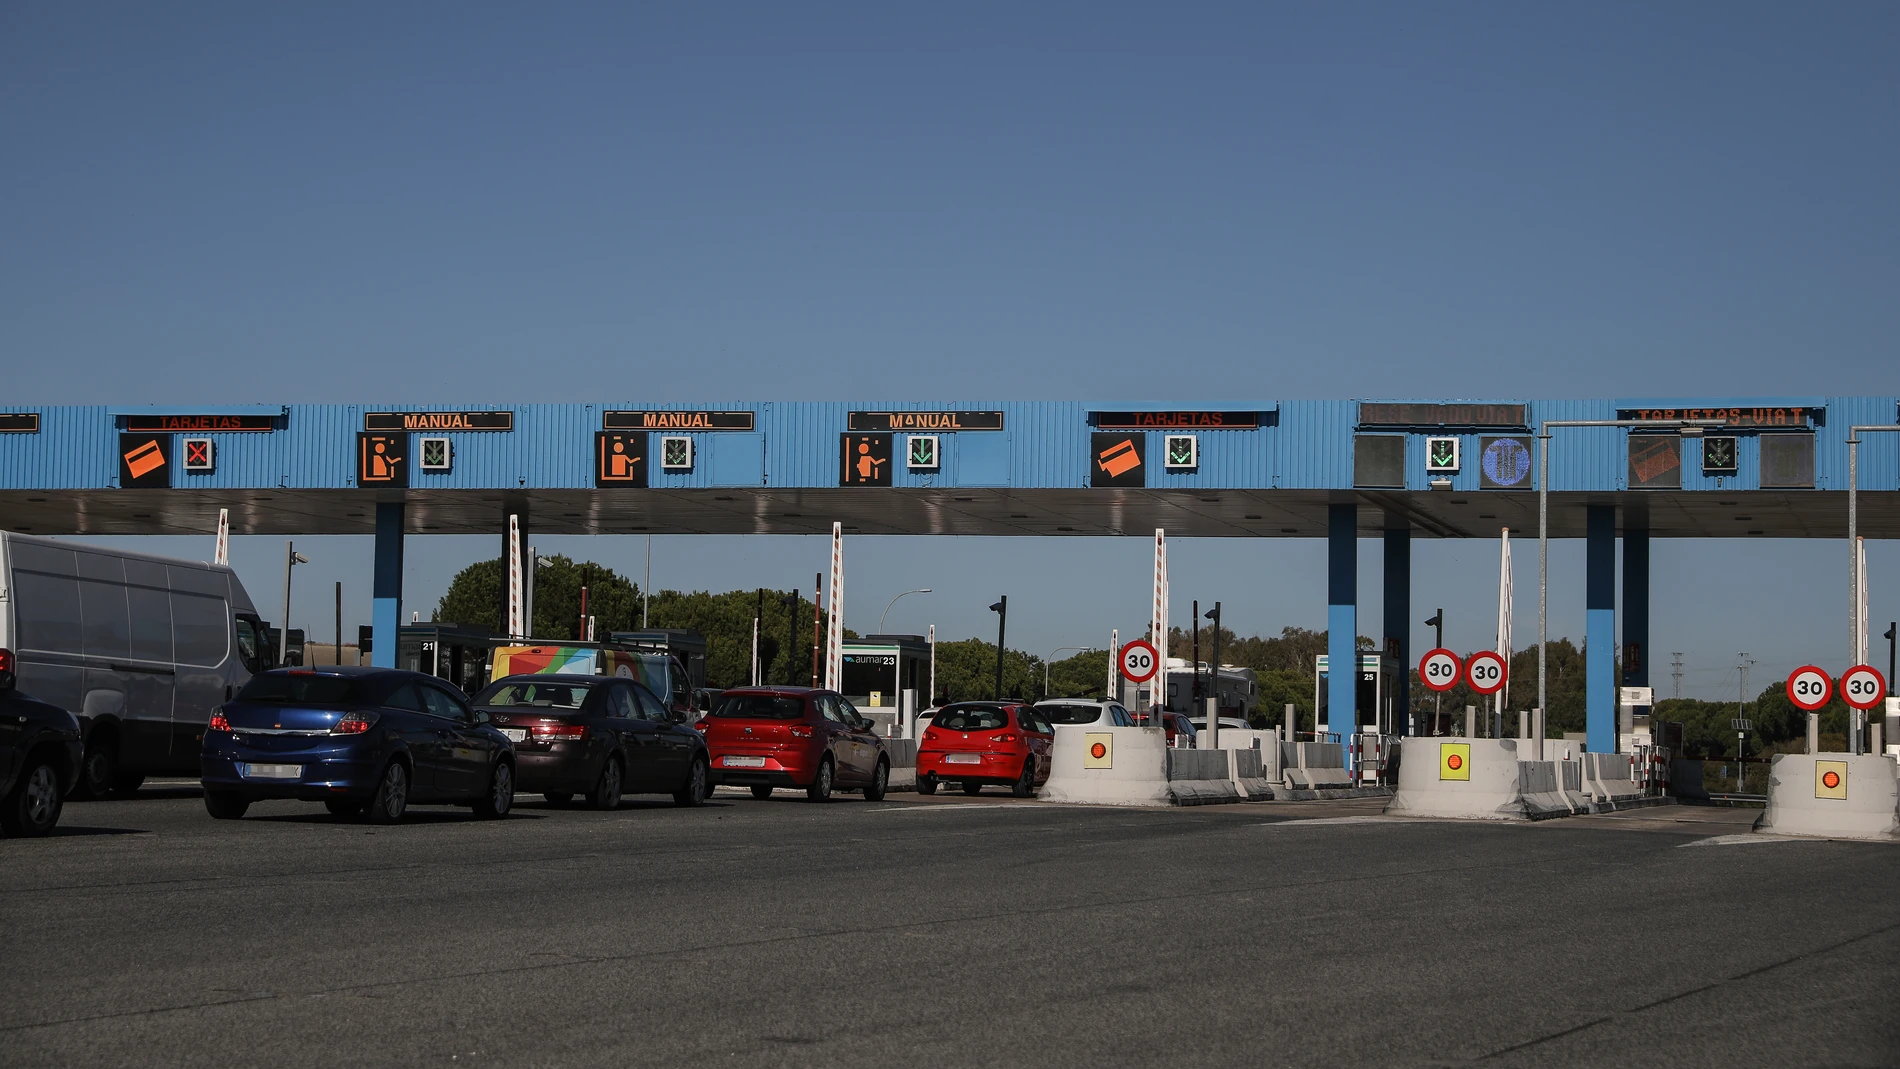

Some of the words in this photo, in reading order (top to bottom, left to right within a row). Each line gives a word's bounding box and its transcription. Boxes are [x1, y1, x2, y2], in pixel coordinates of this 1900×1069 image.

[160, 415, 241, 429] TARJETAS
[404, 414, 473, 428] MANUAL
[643, 413, 713, 427] MANUAL
[889, 414, 961, 428] MANUAL
[1132, 411, 1223, 426] TARJETAS
[422, 642, 433, 651] 21
[855, 655, 883, 664] aumar
[883, 656, 895, 665] 23
[1128, 654, 1150, 668] 30
[1428, 662, 1453, 677] 30
[1474, 665, 1499, 680] 30
[1363, 673, 1374, 681] 25
[1797, 680, 1823, 696] 30
[1850, 680, 1876, 695] 30
